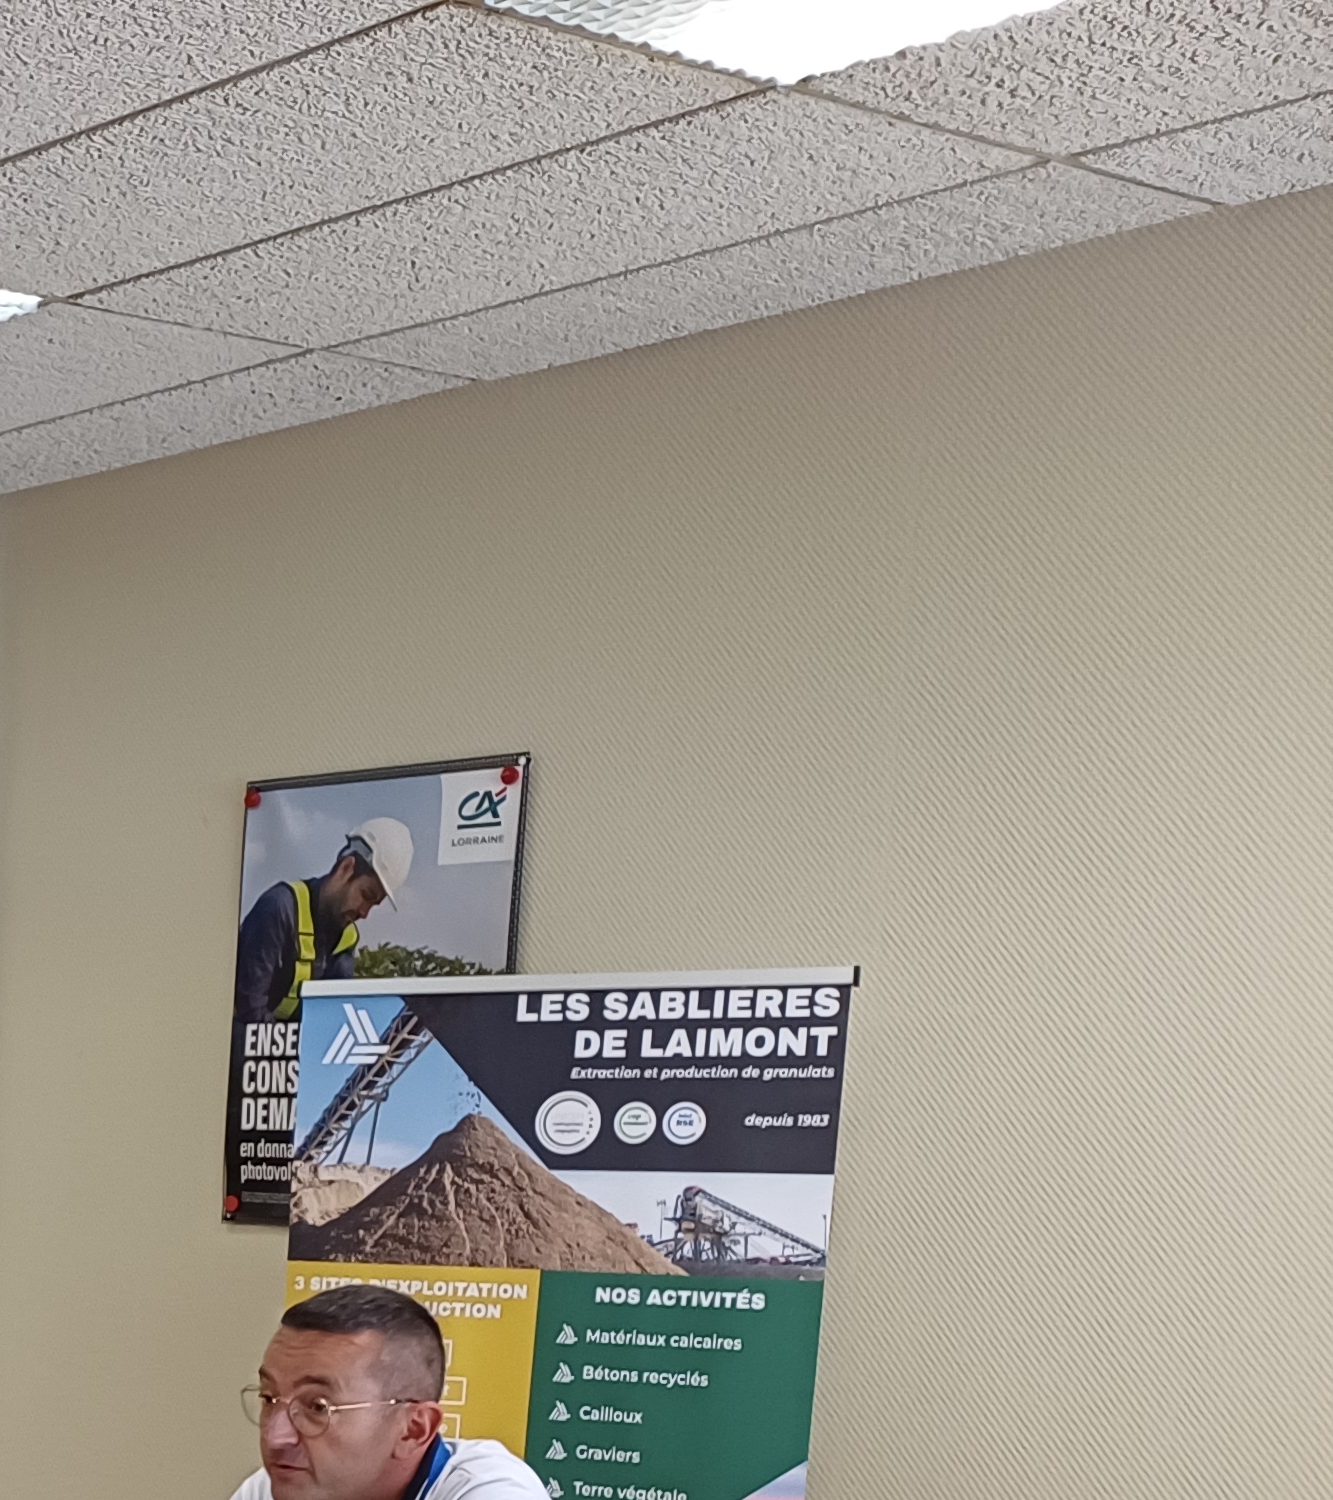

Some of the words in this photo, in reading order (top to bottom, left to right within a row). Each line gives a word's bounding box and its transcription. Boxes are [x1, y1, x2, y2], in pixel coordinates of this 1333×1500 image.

[451, 835, 505, 847] LORRAINE
[516, 993, 590, 1022] LES
[603, 987, 841, 1021] SABLIERES
[244, 1022, 301, 1057] ENSE
[574, 1028, 628, 1058] DE
[640, 1026, 839, 1058] LAIMONT
[570, 1066, 640, 1079] Extraction
[644, 1067, 658, 1078] et
[660, 1066, 738, 1080] production
[741, 1066, 759, 1079] de
[762, 1066, 835, 1081] granulats
[744, 1113, 794, 1128] depuis
[797, 1113, 830, 1127] 1983
[240, 1142, 254, 1157] en
[257, 1138, 295, 1158] donna
[294, 1276, 304, 1290] 3
[595, 1287, 641, 1304] NOS
[646, 1288, 766, 1310] ACTIVITÉS
[586, 1329, 667, 1347] Matériaux
[670, 1332, 742, 1351] calcaires
[582, 1365, 639, 1383] Bétons
[642, 1370, 709, 1388] recyclés
[579, 1406, 643, 1424] Cailloux
[576, 1445, 641, 1463] Graviers
[573, 1481, 614, 1498] Terre
